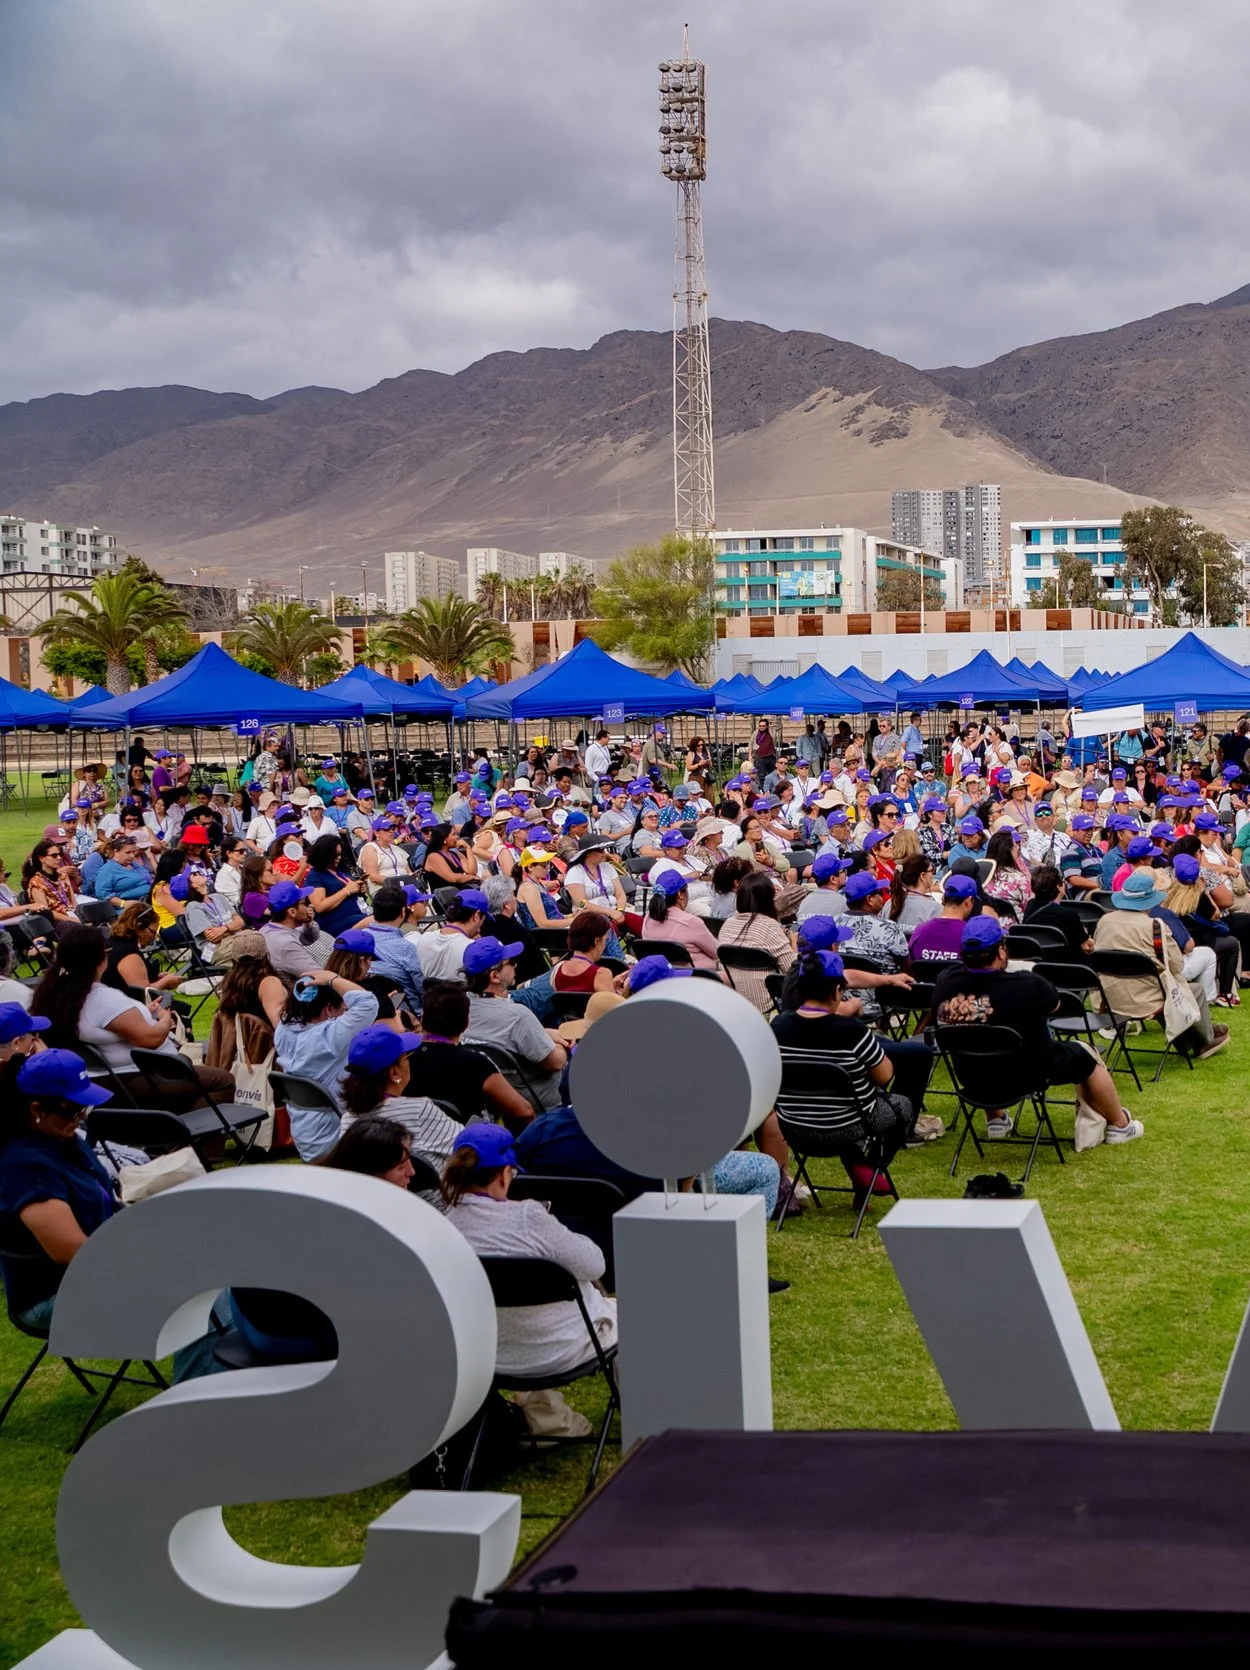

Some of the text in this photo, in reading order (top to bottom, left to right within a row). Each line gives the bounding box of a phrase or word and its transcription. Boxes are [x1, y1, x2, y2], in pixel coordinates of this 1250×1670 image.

[606, 708, 622, 718] 123
[1179, 707, 1195, 717] 121
[240, 718, 259, 729] 126
[922, 949, 958, 961] STAFF
[236, 1089, 262, 1102] envis
